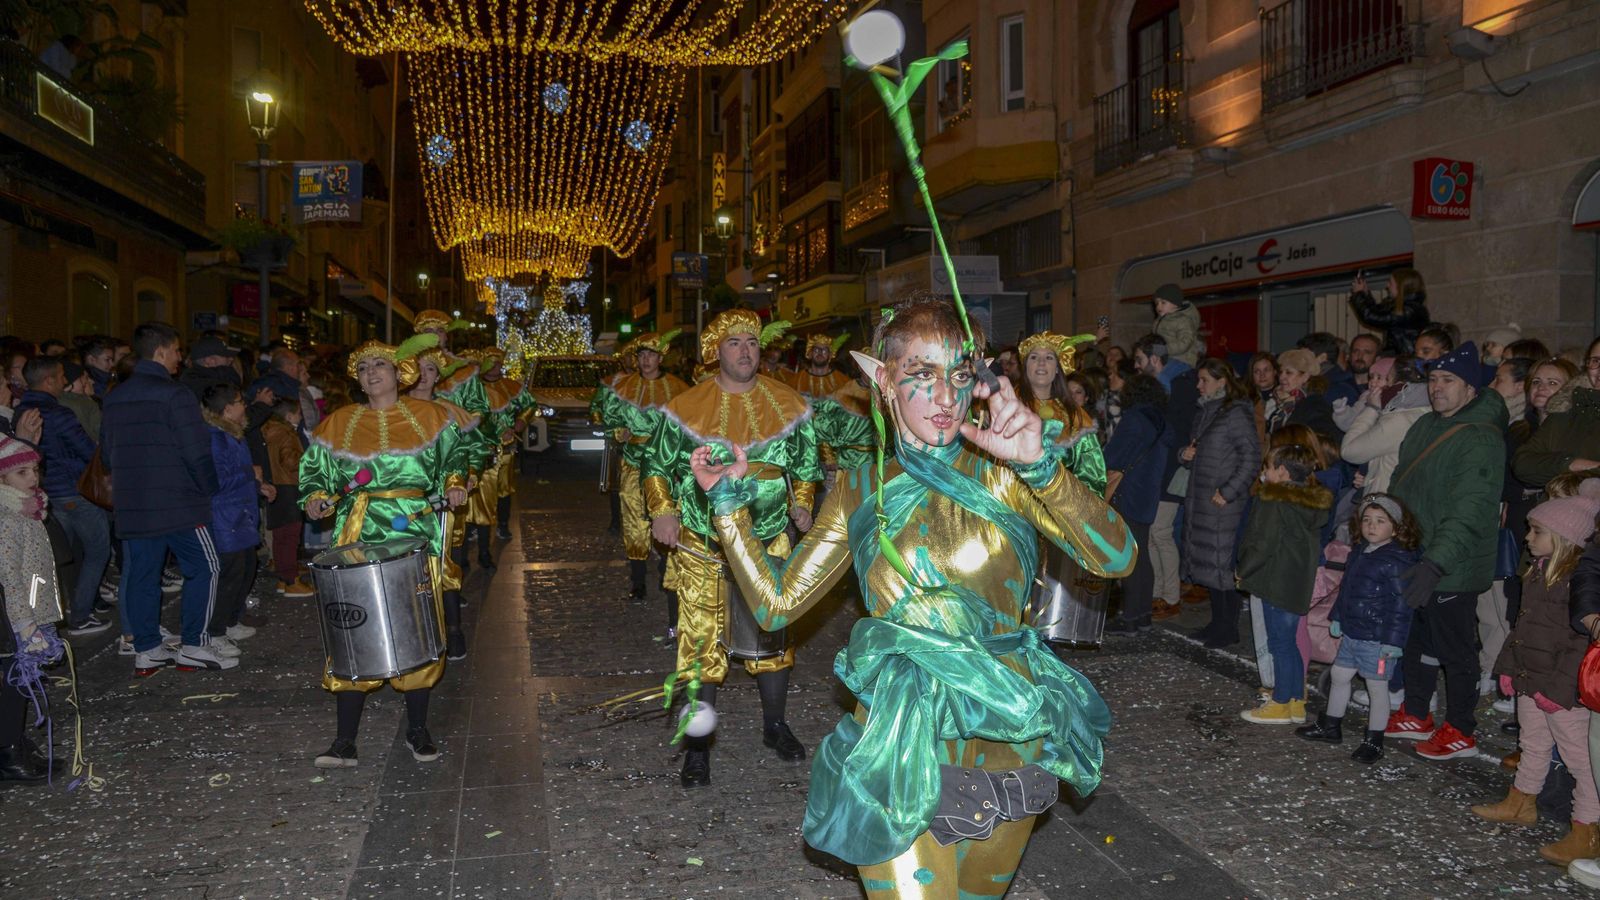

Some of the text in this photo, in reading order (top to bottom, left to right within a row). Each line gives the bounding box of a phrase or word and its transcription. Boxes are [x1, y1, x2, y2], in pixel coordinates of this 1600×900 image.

[303, 202, 350, 212] DACIA
[1427, 205, 1470, 217] EURO 6000
[303, 209, 350, 220] JAPEMASA
[1181, 243, 1317, 280] iberCaja Jaén
